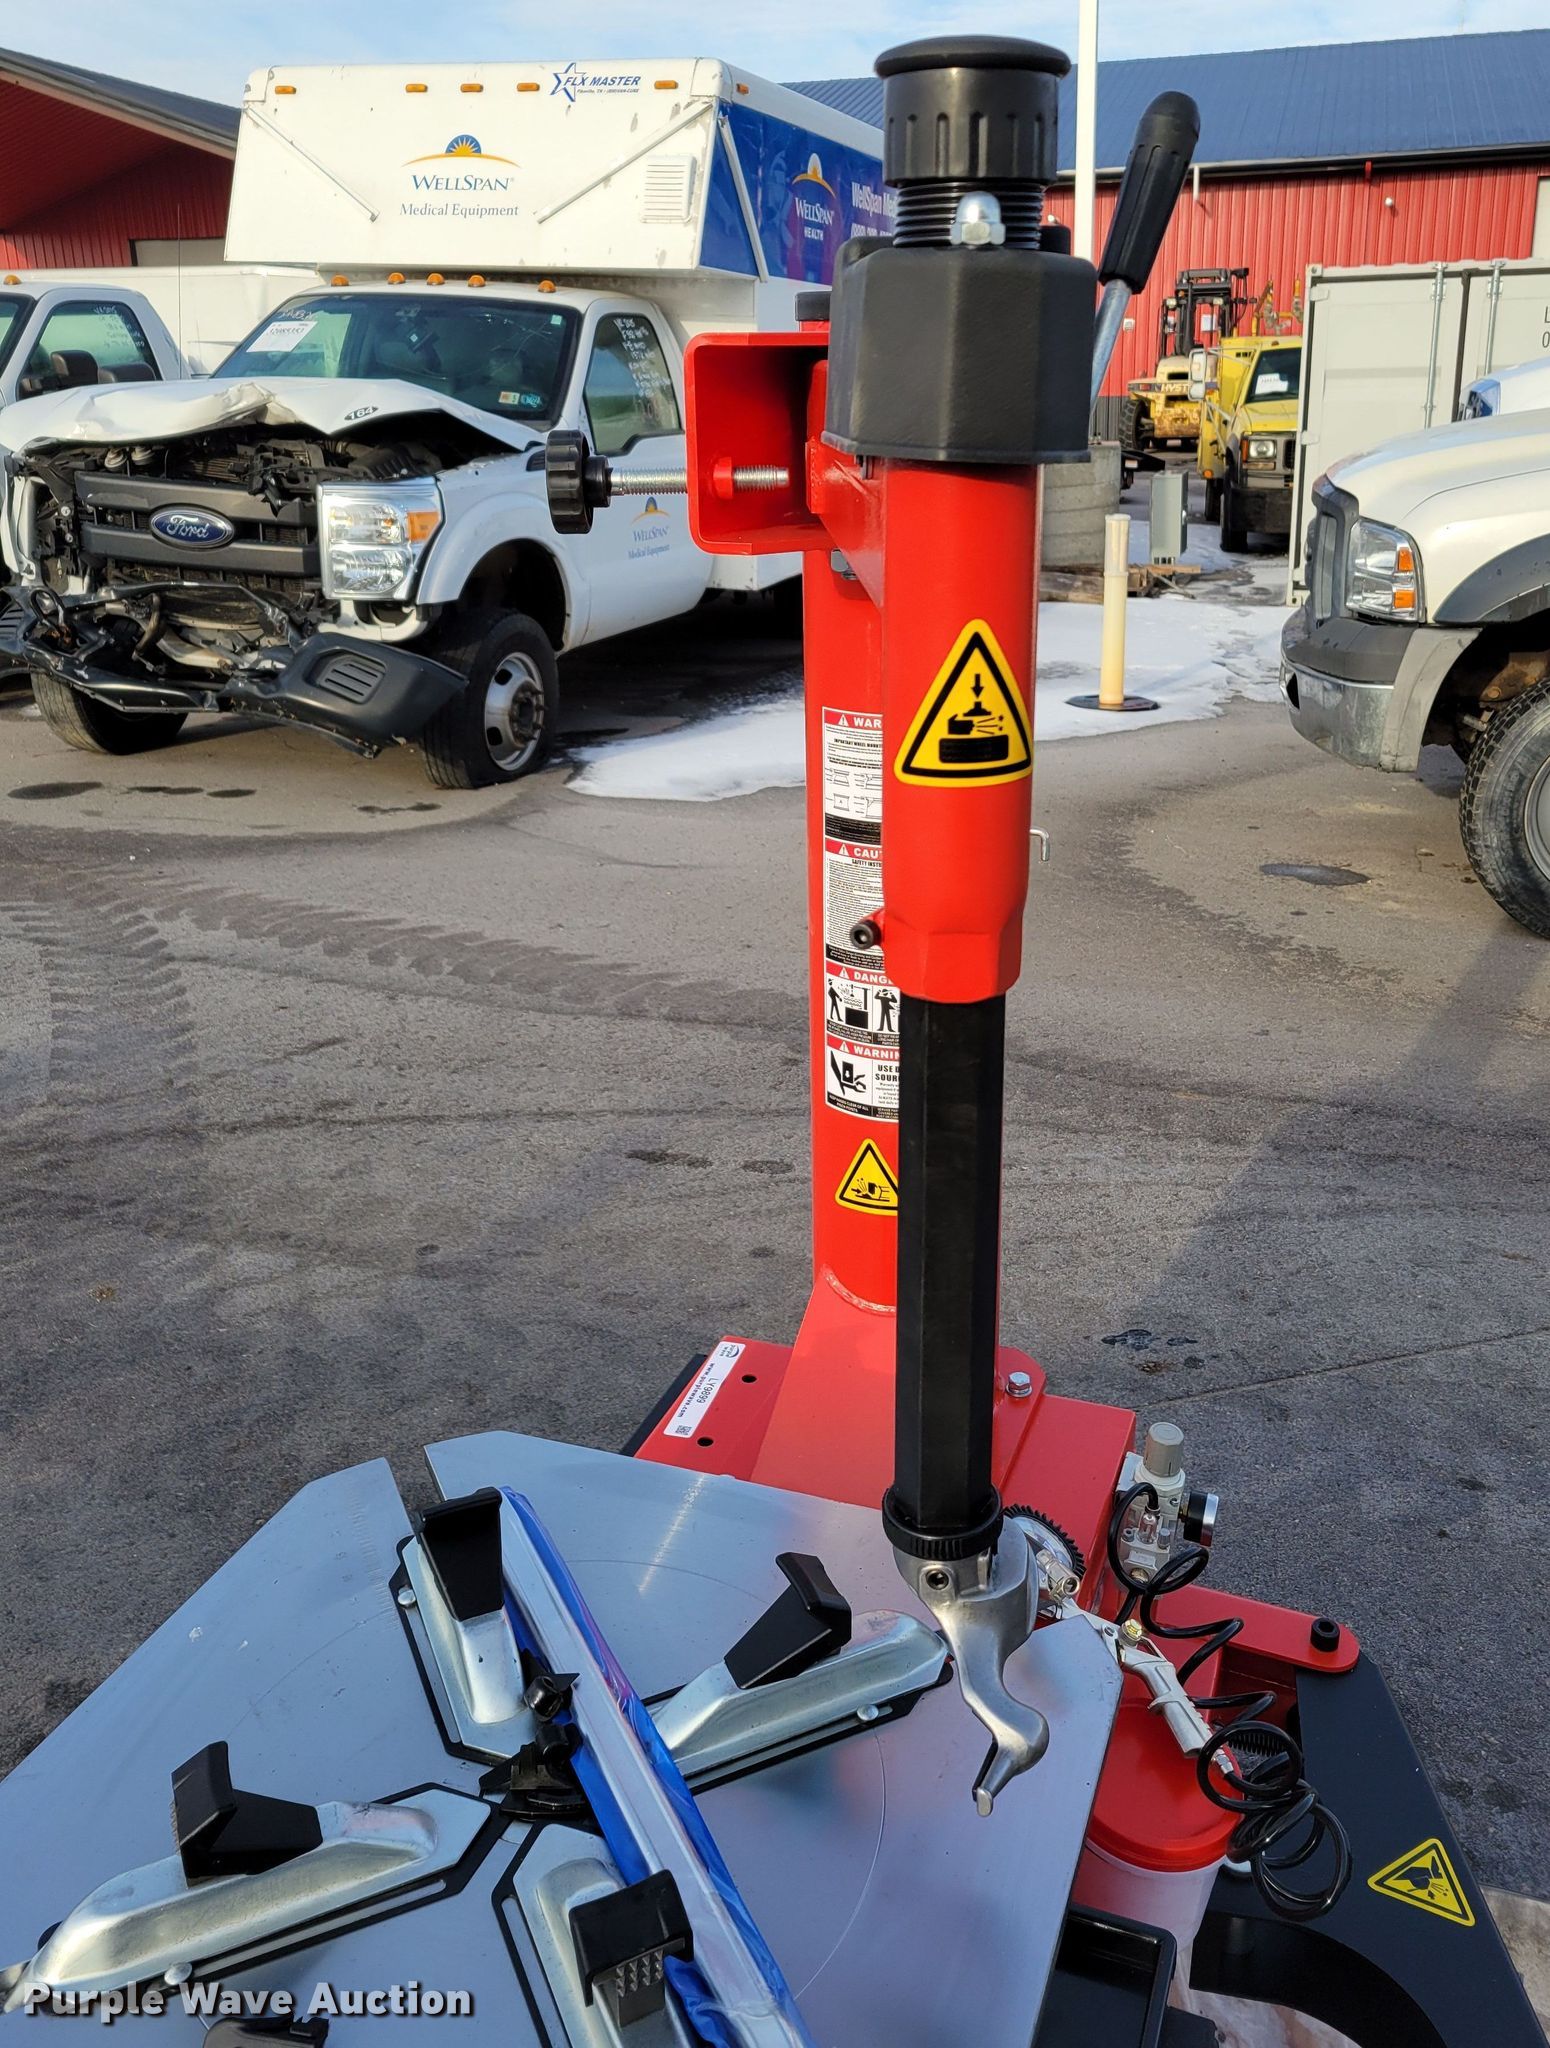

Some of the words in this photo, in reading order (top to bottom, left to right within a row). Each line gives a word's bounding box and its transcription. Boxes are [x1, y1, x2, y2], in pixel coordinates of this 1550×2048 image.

[590, 76, 642, 86] MASTER
[851, 181, 882, 218] WellSpan
[399, 202, 449, 216] Medical
[451, 203, 519, 219] Equipment
[804, 226, 824, 241] HEALTH
[350, 406, 373, 420] 164
[166, 514, 210, 539] Ford
[853, 716, 882, 728] WAR
[877, 1064, 893, 1073] USE
